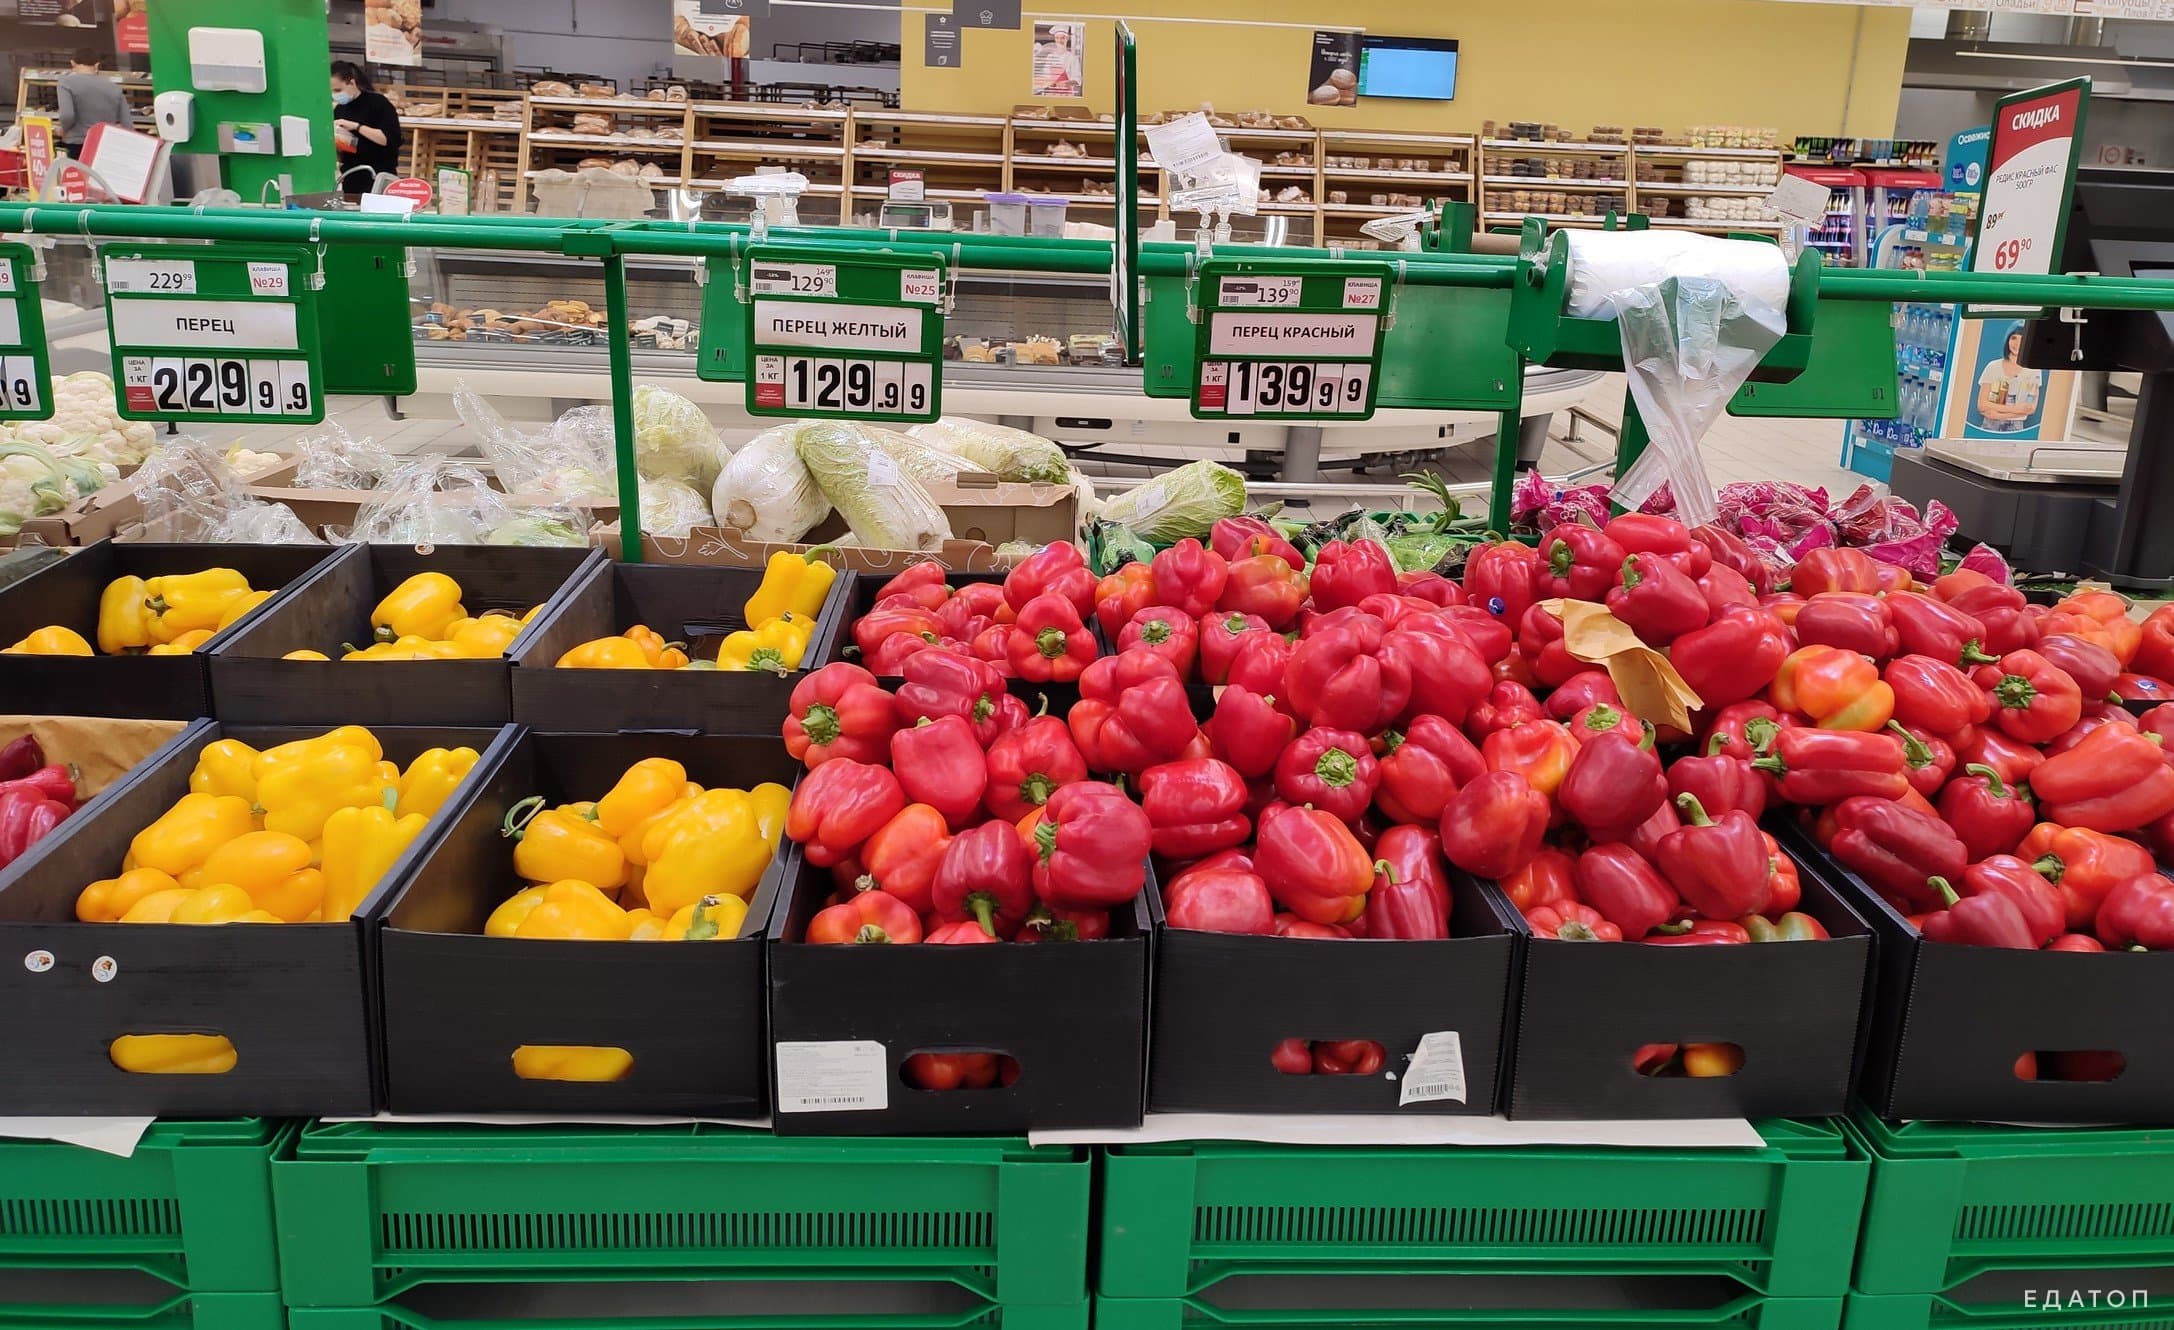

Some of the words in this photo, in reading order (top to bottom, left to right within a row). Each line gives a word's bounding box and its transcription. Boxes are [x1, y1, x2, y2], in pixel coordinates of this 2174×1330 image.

[2011, 104, 2061, 131] СКИДКА
[1995, 172, 2015, 184] РЕДИС
[2015, 164, 2044, 179] КРАСНЫЙ
[1994, 239, 2019, 270] 69
[253, 277, 283, 288] №29
[905, 284, 936, 296] №25
[1347, 294, 1375, 304] №27
[176, 317, 235, 335] ПЕРЕЦ
[772, 318, 827, 337] ПЕРЕЦ
[832, 321, 907, 339] ЖЕЛТЫЙ
[1232, 326, 1279, 340] ПЕРЕЦ
[1283, 324, 1356, 339] КРАСНЫЙ
[761, 372, 766, 380] 1
[768, 372, 779, 380] КГ
